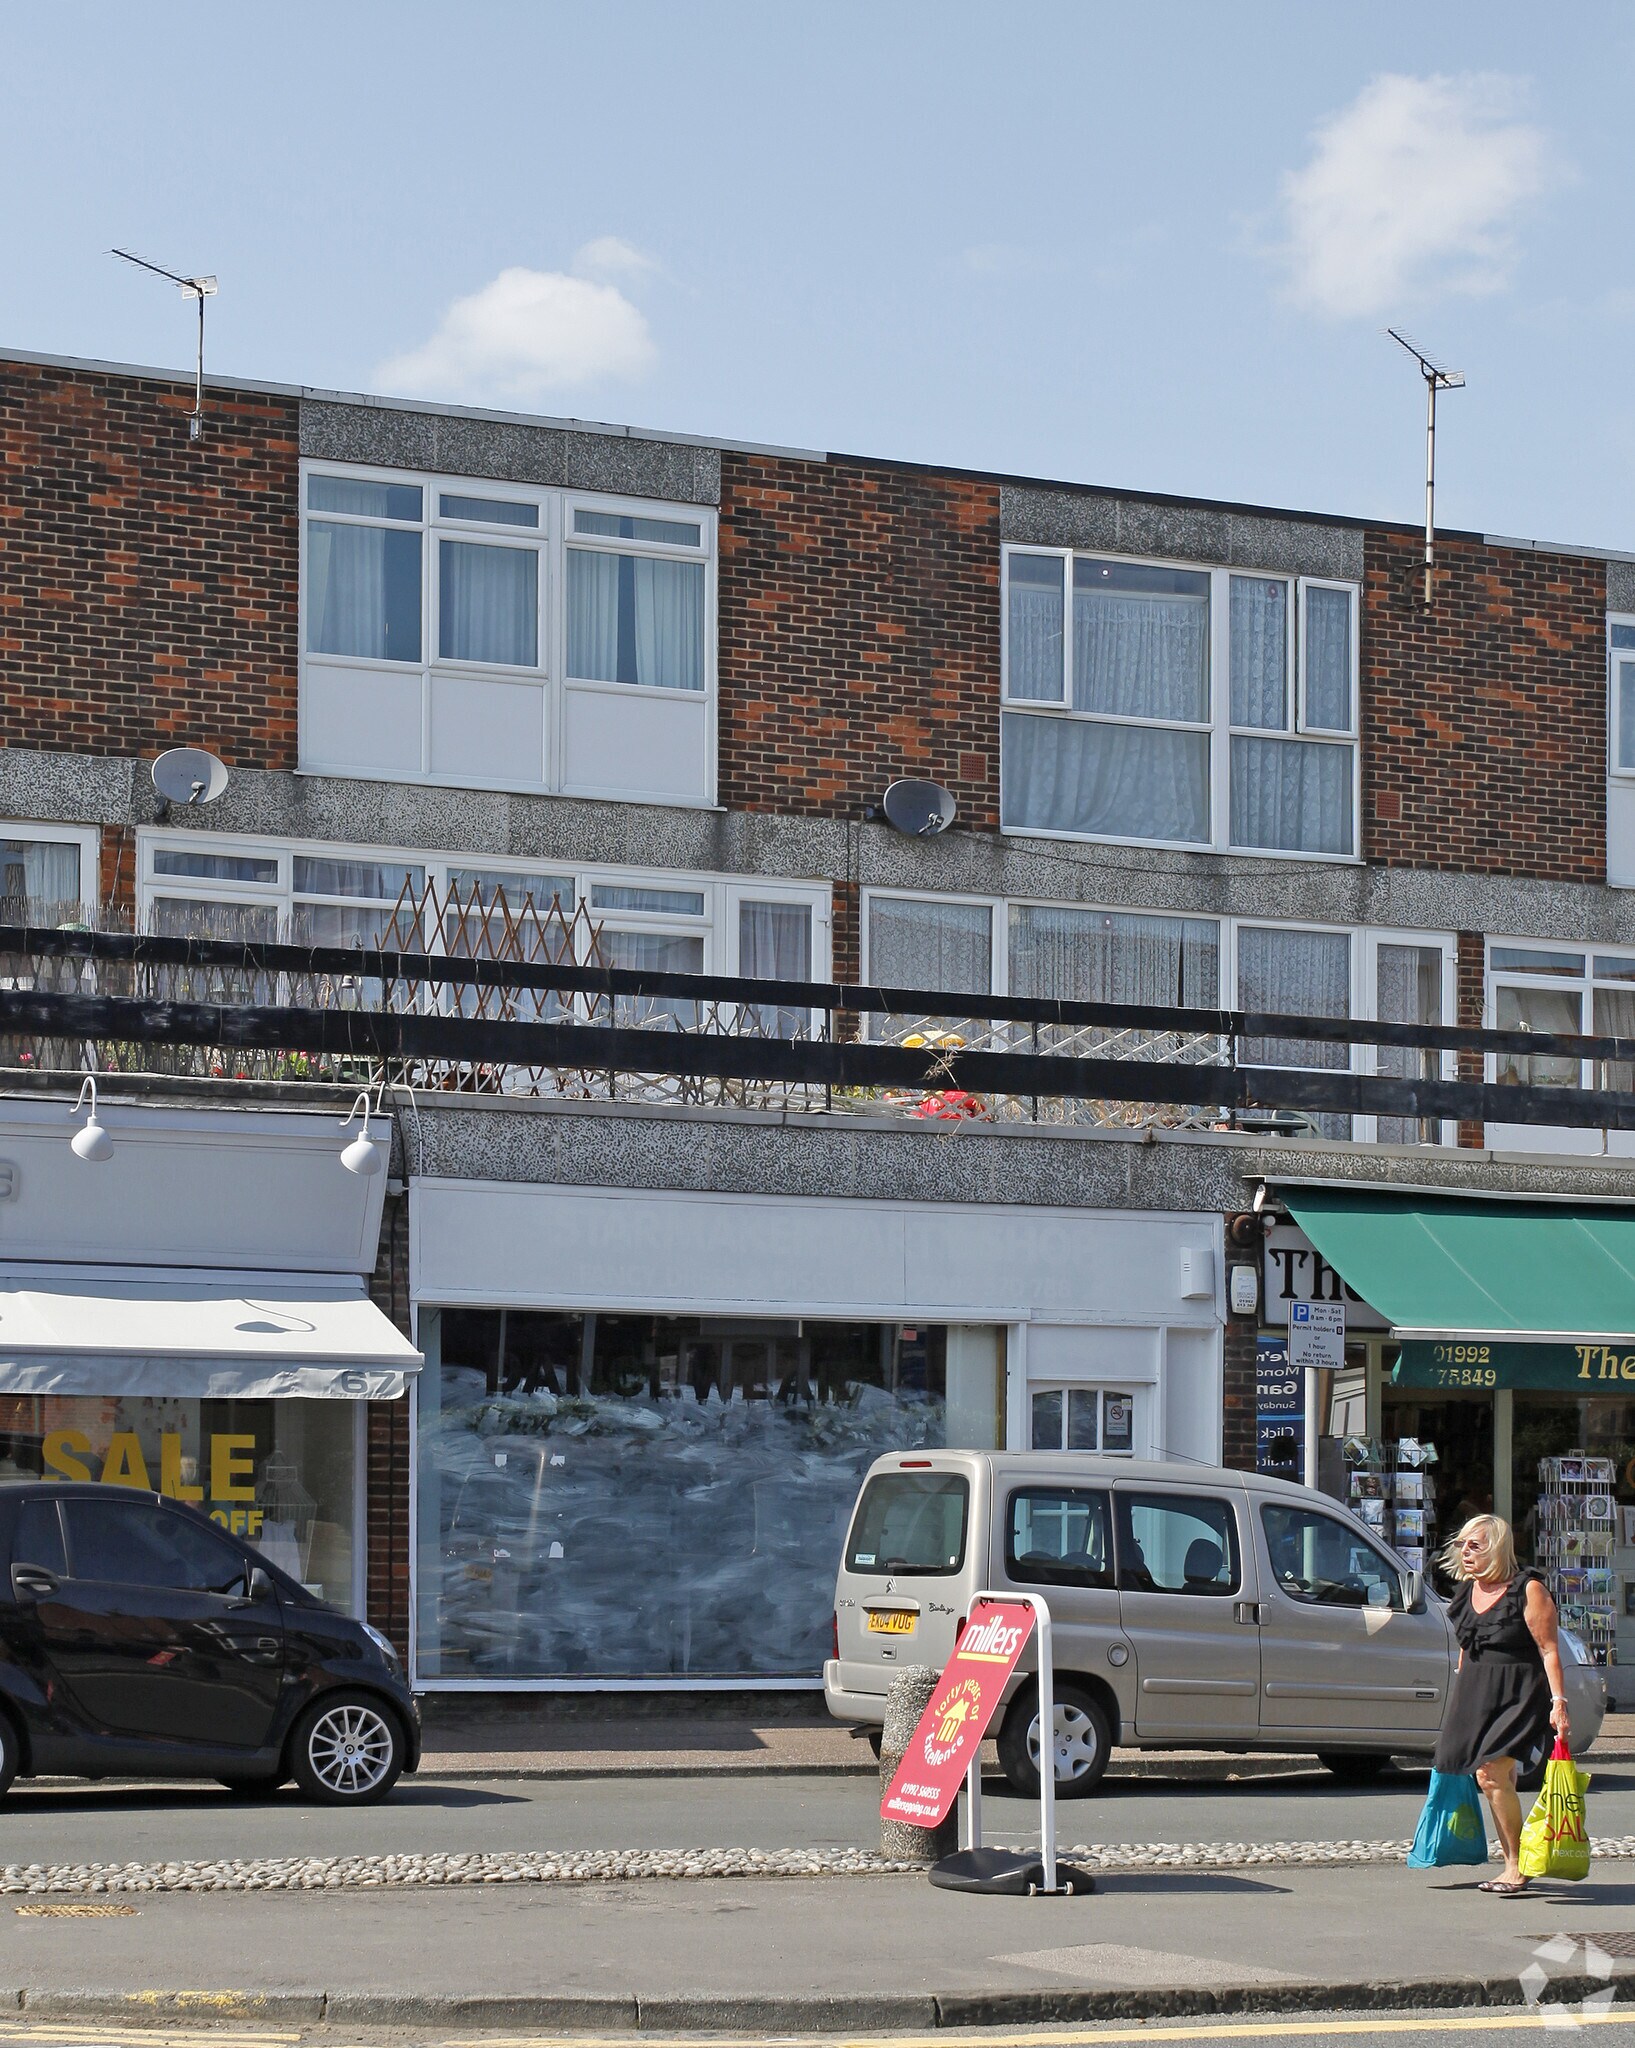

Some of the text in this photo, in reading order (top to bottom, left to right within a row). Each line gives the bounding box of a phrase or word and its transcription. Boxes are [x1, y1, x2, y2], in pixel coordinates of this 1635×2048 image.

[1268, 1247, 1366, 1302] Th
[1297, 1306, 1307, 1320] P
[1575, 1345, 1635, 1380] The
[341, 1371, 396, 1394] 67
[41, 1430, 256, 1501] SALE
[960, 1615, 1023, 1656] millers
[934, 1679, 981, 1721] forty years of
[924, 1732, 965, 1767] Excellence
[900, 1782, 920, 1797] 01992
